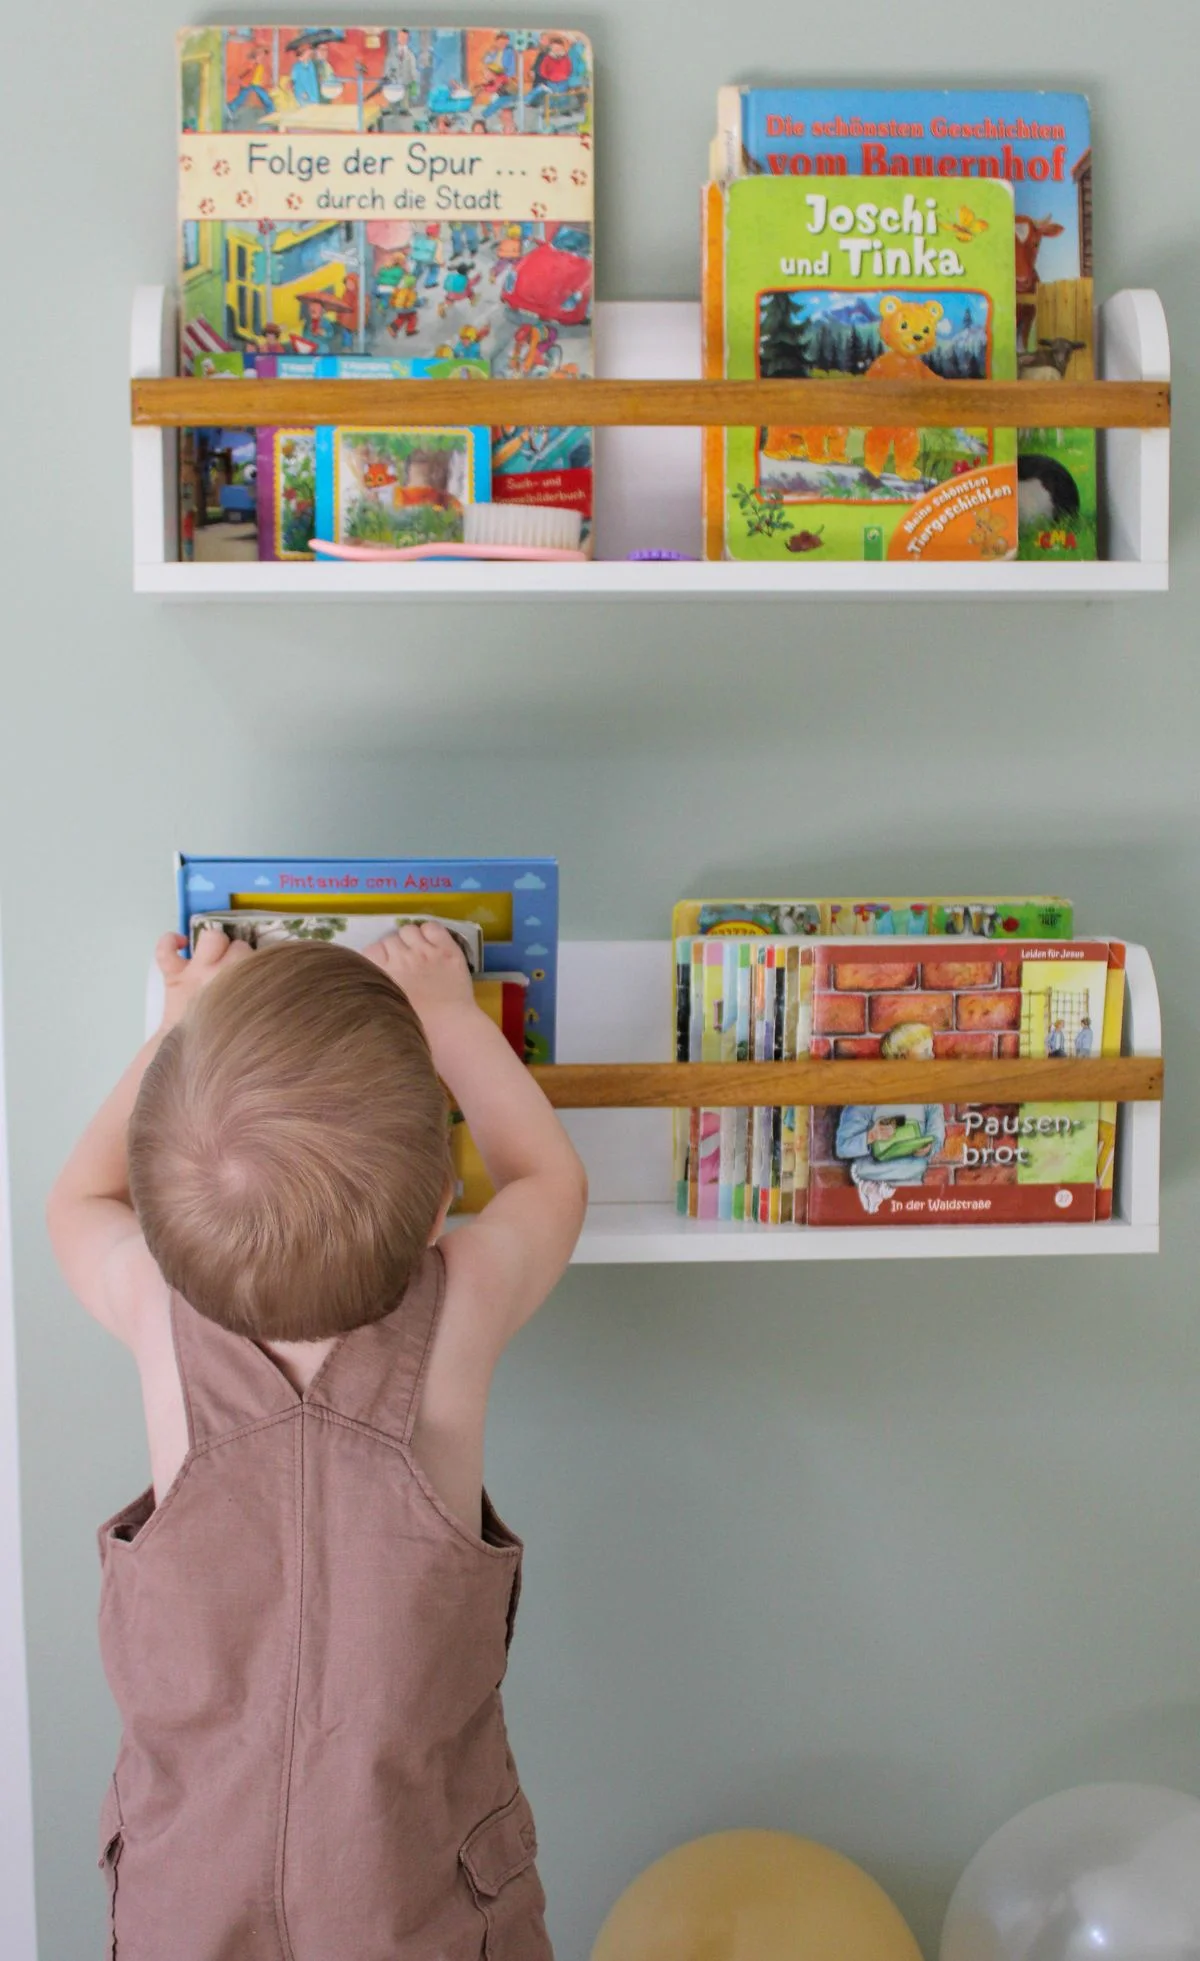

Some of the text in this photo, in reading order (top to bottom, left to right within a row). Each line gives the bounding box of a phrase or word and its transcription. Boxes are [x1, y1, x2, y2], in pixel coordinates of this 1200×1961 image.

[766, 114, 1066, 139] Die schönsten Geschichten
[247, 143, 330, 181] Folge
[344, 148, 394, 175] der
[406, 142, 483, 181] Spur
[766, 152, 847, 176] vom
[861, 142, 1068, 181] Bauernhof
[316, 185, 502, 210] durch die Stadt
[805, 194, 938, 235] Joschi
[780, 235, 965, 277] und Tinka
[542, 475, 561, 488] und
[903, 476, 989, 533] Meine schönsten
[906, 484, 1012, 553] Tiergeschichten
[279, 872, 453, 892] Pintando con Agua
[1047, 949, 1060, 959] für
[1060, 949, 1085, 959] Jesus
[962, 1111, 1081, 1136] Pausen-
[962, 1143, 1029, 1166] brot
[890, 1198, 992, 1212] In der Waldstraße
